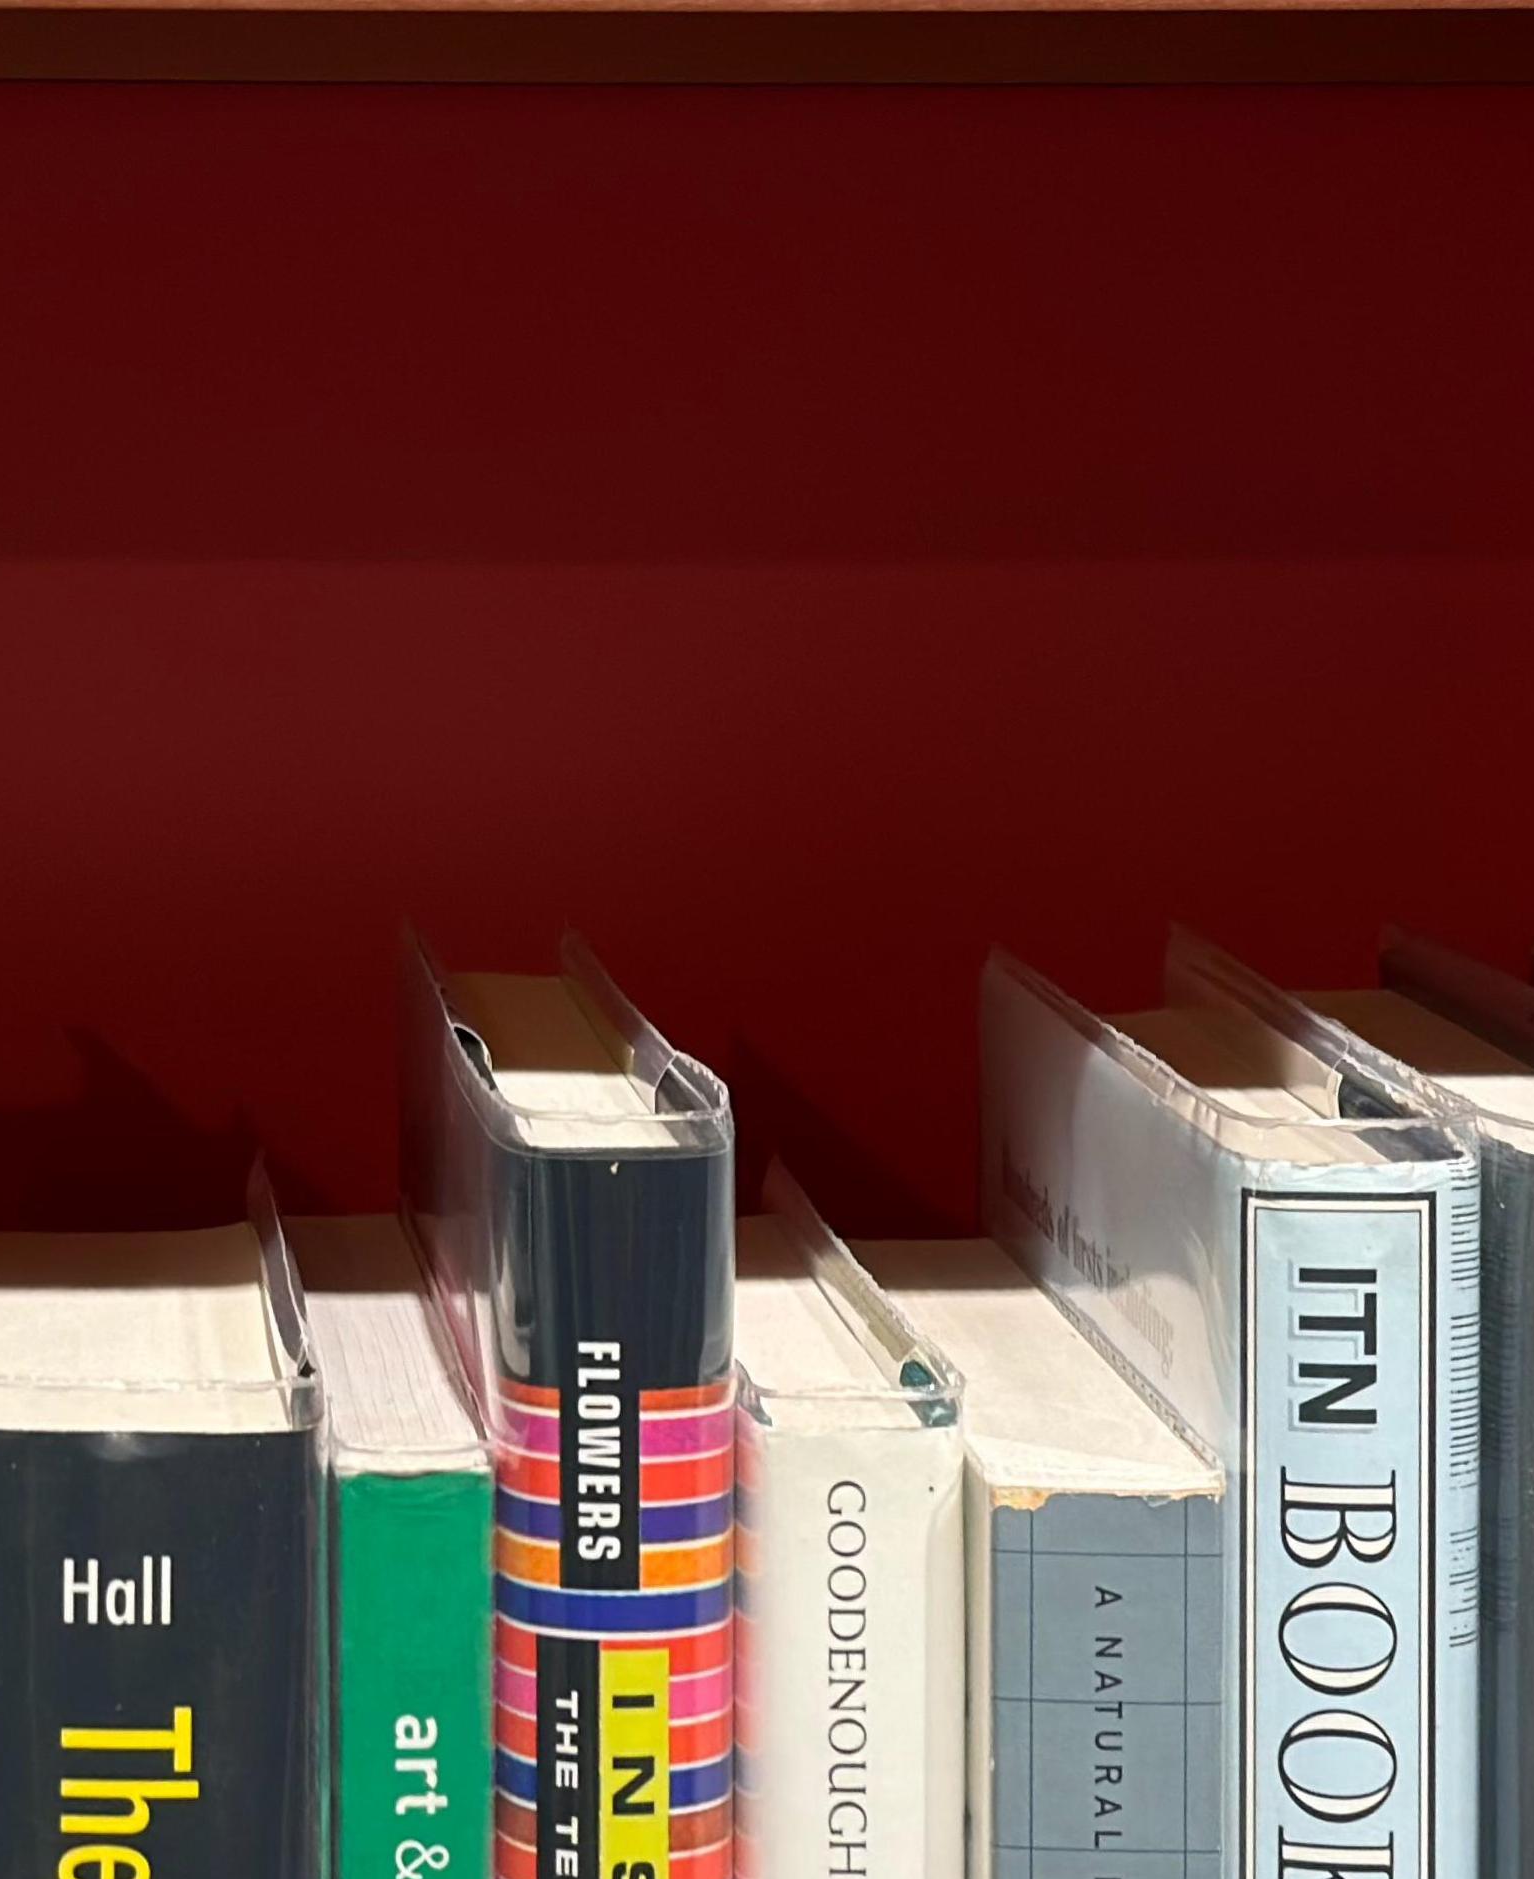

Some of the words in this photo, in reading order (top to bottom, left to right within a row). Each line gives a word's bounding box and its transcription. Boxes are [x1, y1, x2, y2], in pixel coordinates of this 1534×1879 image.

[1284, 1266, 1377, 1430] ITN
[577, 1341, 621, 1562] FLOWERS
[64, 1556, 171, 1627] Hall
[825, 1482, 869, 1877] GOODENOUGH
[396, 1715, 448, 1819] art
[1093, 1635, 1123, 1849] NATURAL
